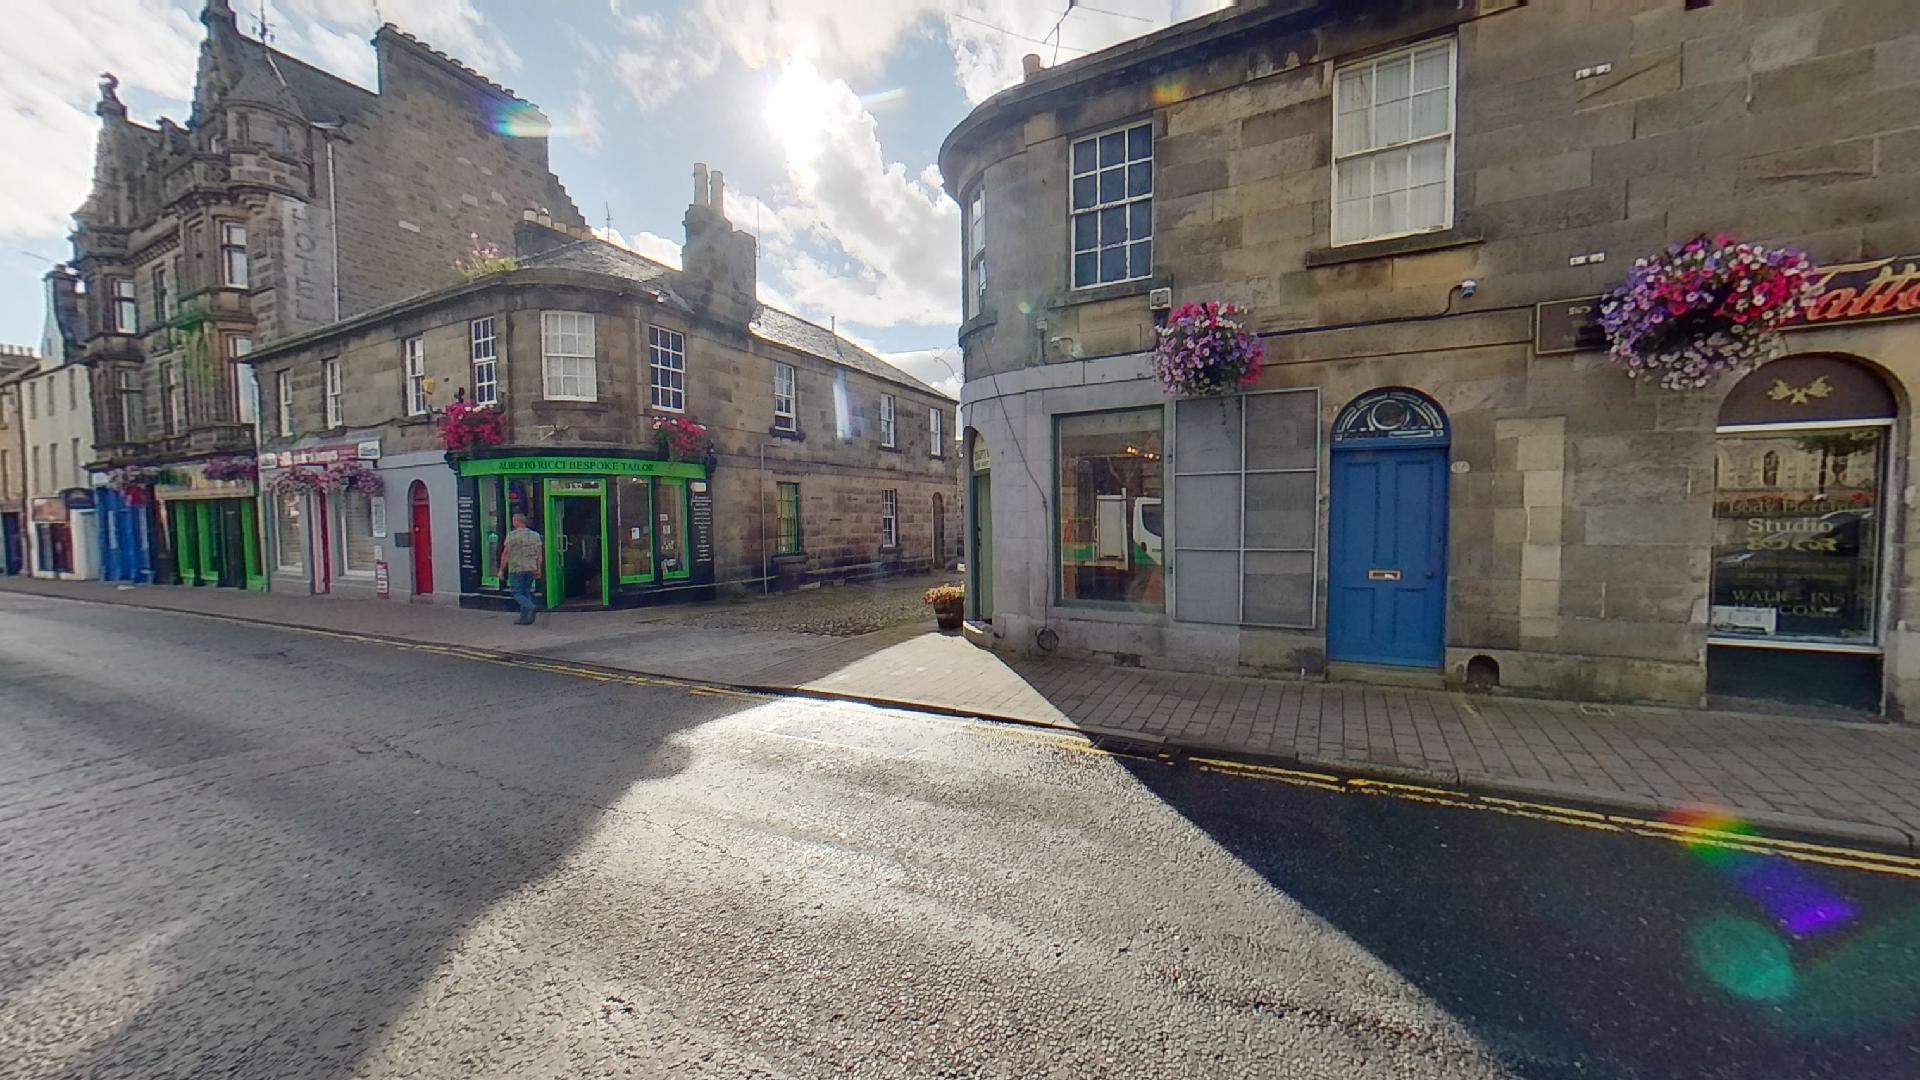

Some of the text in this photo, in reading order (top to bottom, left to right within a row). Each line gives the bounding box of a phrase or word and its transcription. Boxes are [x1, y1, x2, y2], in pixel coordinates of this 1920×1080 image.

[499, 461, 654, 472] ALBERTO RICCI BESPOKE TAILOR
[1747, 518, 1834, 533] Studio
[1731, 590, 1790, 602] WALK
[1811, 592, 1846, 604] INS
